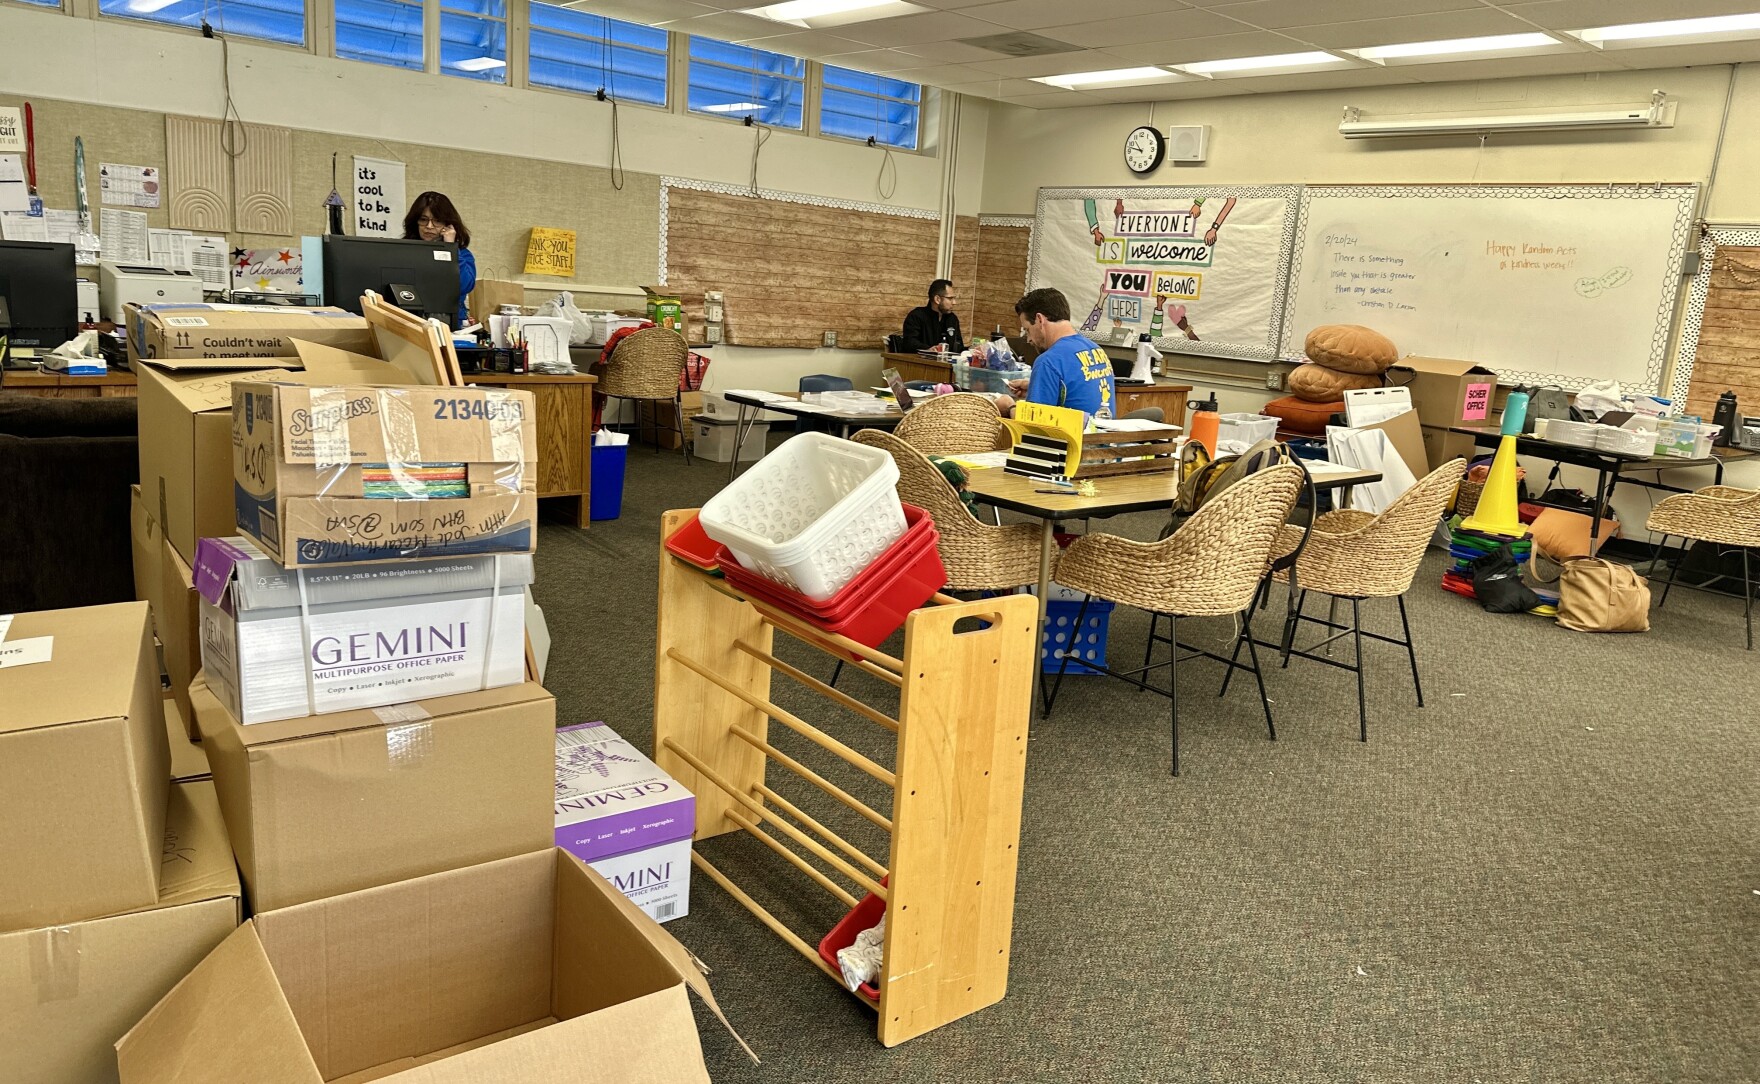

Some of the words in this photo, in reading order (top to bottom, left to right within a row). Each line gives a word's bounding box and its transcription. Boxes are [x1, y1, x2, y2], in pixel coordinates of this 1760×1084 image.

[359, 167, 376, 180] it's
[358, 185, 383, 196] cool
[358, 199, 373, 211] to
[376, 200, 390, 213] be
[359, 216, 387, 231] kind
[1120, 215, 1191, 232] EVERYONE
[550, 240, 567, 253] YOU
[1325, 234, 1358, 247] 2/20/24
[1103, 242, 1120, 260] IS
[1131, 242, 1208, 261] welcome
[1486, 240, 1516, 257] Happy
[1522, 242, 1554, 255] Random
[546, 254, 573, 269] STAFF!
[1334, 252, 1355, 263] There
[1110, 272, 1147, 291] YOU
[1351, 272, 1359, 282] you
[1390, 272, 1416, 281] greater
[1112, 299, 1138, 318] HERE
[203, 337, 254, 348] Couldn't
[259, 337, 282, 348] wait
[1076, 351, 1095, 366] WE
[1468, 390, 1487, 398] SCHER
[1466, 401, 1485, 410] OFFICE
[289, 396, 373, 436] Surpass
[389, 569, 425, 577] Brightness
[312, 622, 466, 665] GEMINI
[314, 664, 393, 680] MULTIPURPOSE
[397, 658, 432, 670] OFFICE
[435, 654, 464, 665] PAPER
[327, 686, 347, 694] Copy
[356, 682, 375, 690] Laser
[385, 678, 405, 686] Inkjet
[414, 672, 455, 682] Xerographic
[598, 832, 614, 840] Laser
[620, 827, 636, 835] Inkjet
[643, 818, 674, 829] Xerographic
[606, 862, 670, 891] MINI
[627, 889, 648, 899] OFFICE
[650, 884, 668, 892] PAPER
